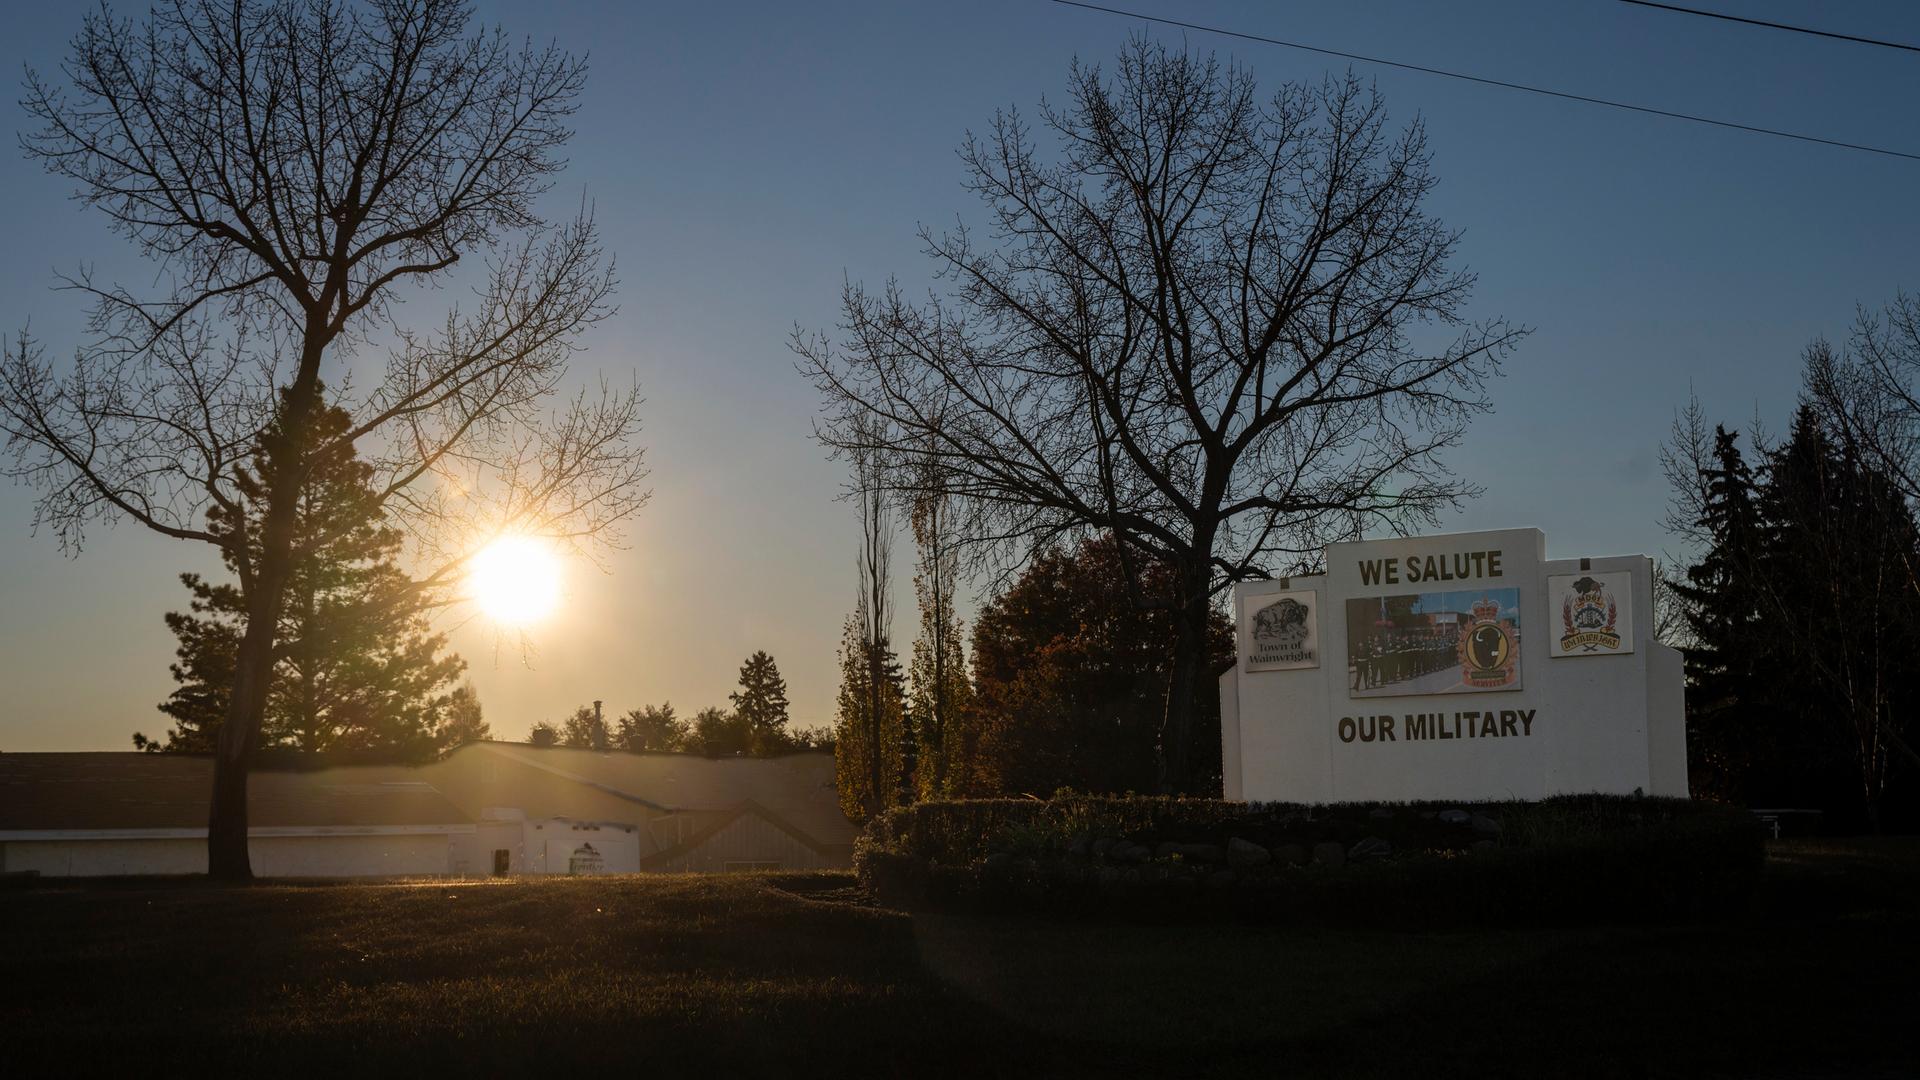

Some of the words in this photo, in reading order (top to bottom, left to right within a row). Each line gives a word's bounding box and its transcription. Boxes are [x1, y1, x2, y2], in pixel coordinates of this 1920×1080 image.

[1358, 558, 1399, 586] WE
[1406, 550, 1503, 583] SALUTE
[1249, 651, 1312, 663] Wainwright
[1258, 643, 1288, 652] Town
[1290, 640, 1302, 650] of
[1338, 715, 1396, 743] OUR
[1405, 709, 1537, 741] MILITARY
